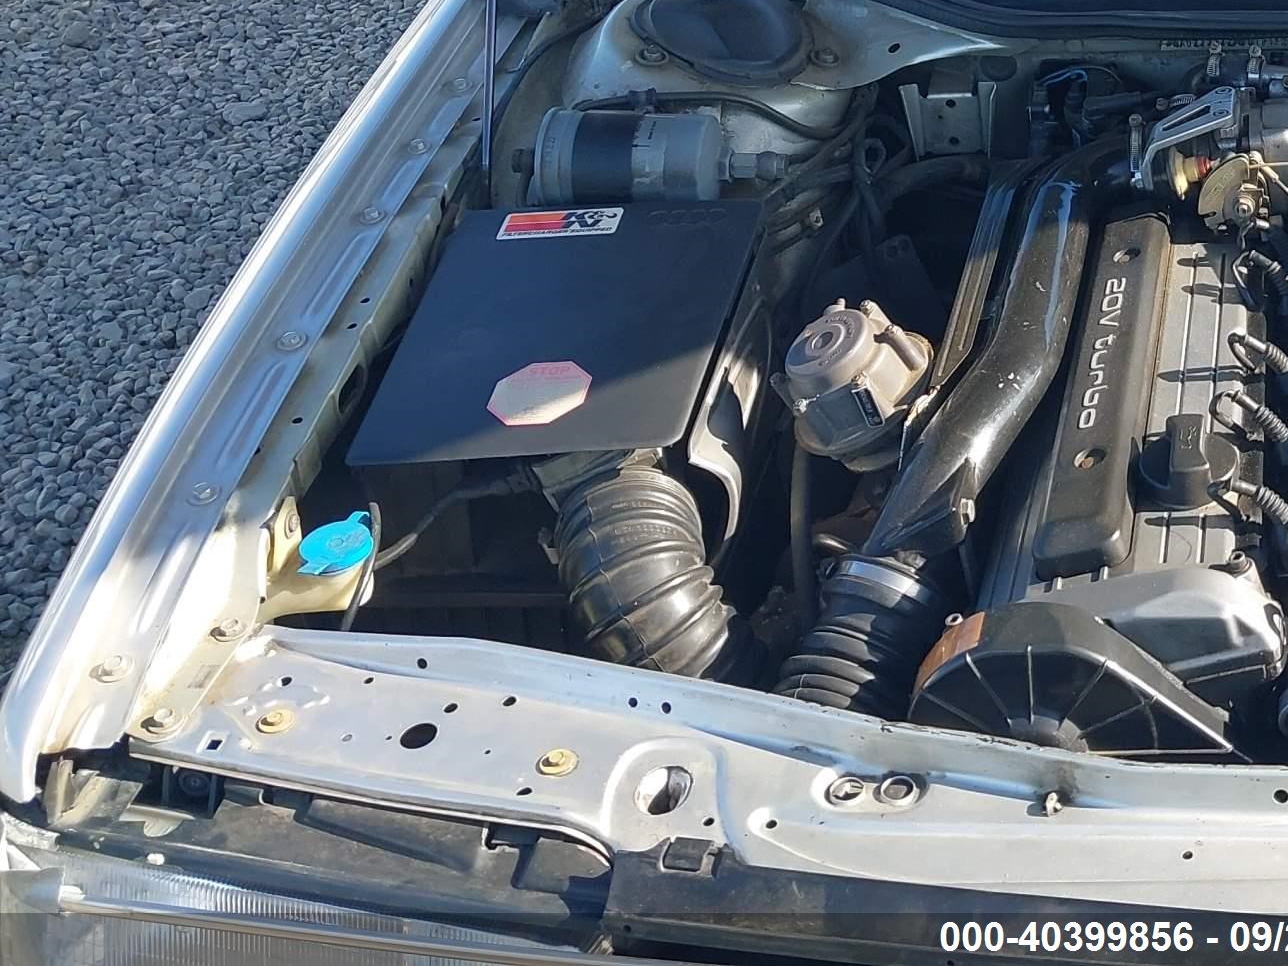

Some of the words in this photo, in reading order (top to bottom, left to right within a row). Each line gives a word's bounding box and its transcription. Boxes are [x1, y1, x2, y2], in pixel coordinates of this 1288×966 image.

[563, 211, 618, 228] K&N
[1098, 276, 1127, 327] 20V
[528, 366, 571, 376] STOP
[1077, 333, 1117, 429] turbo
